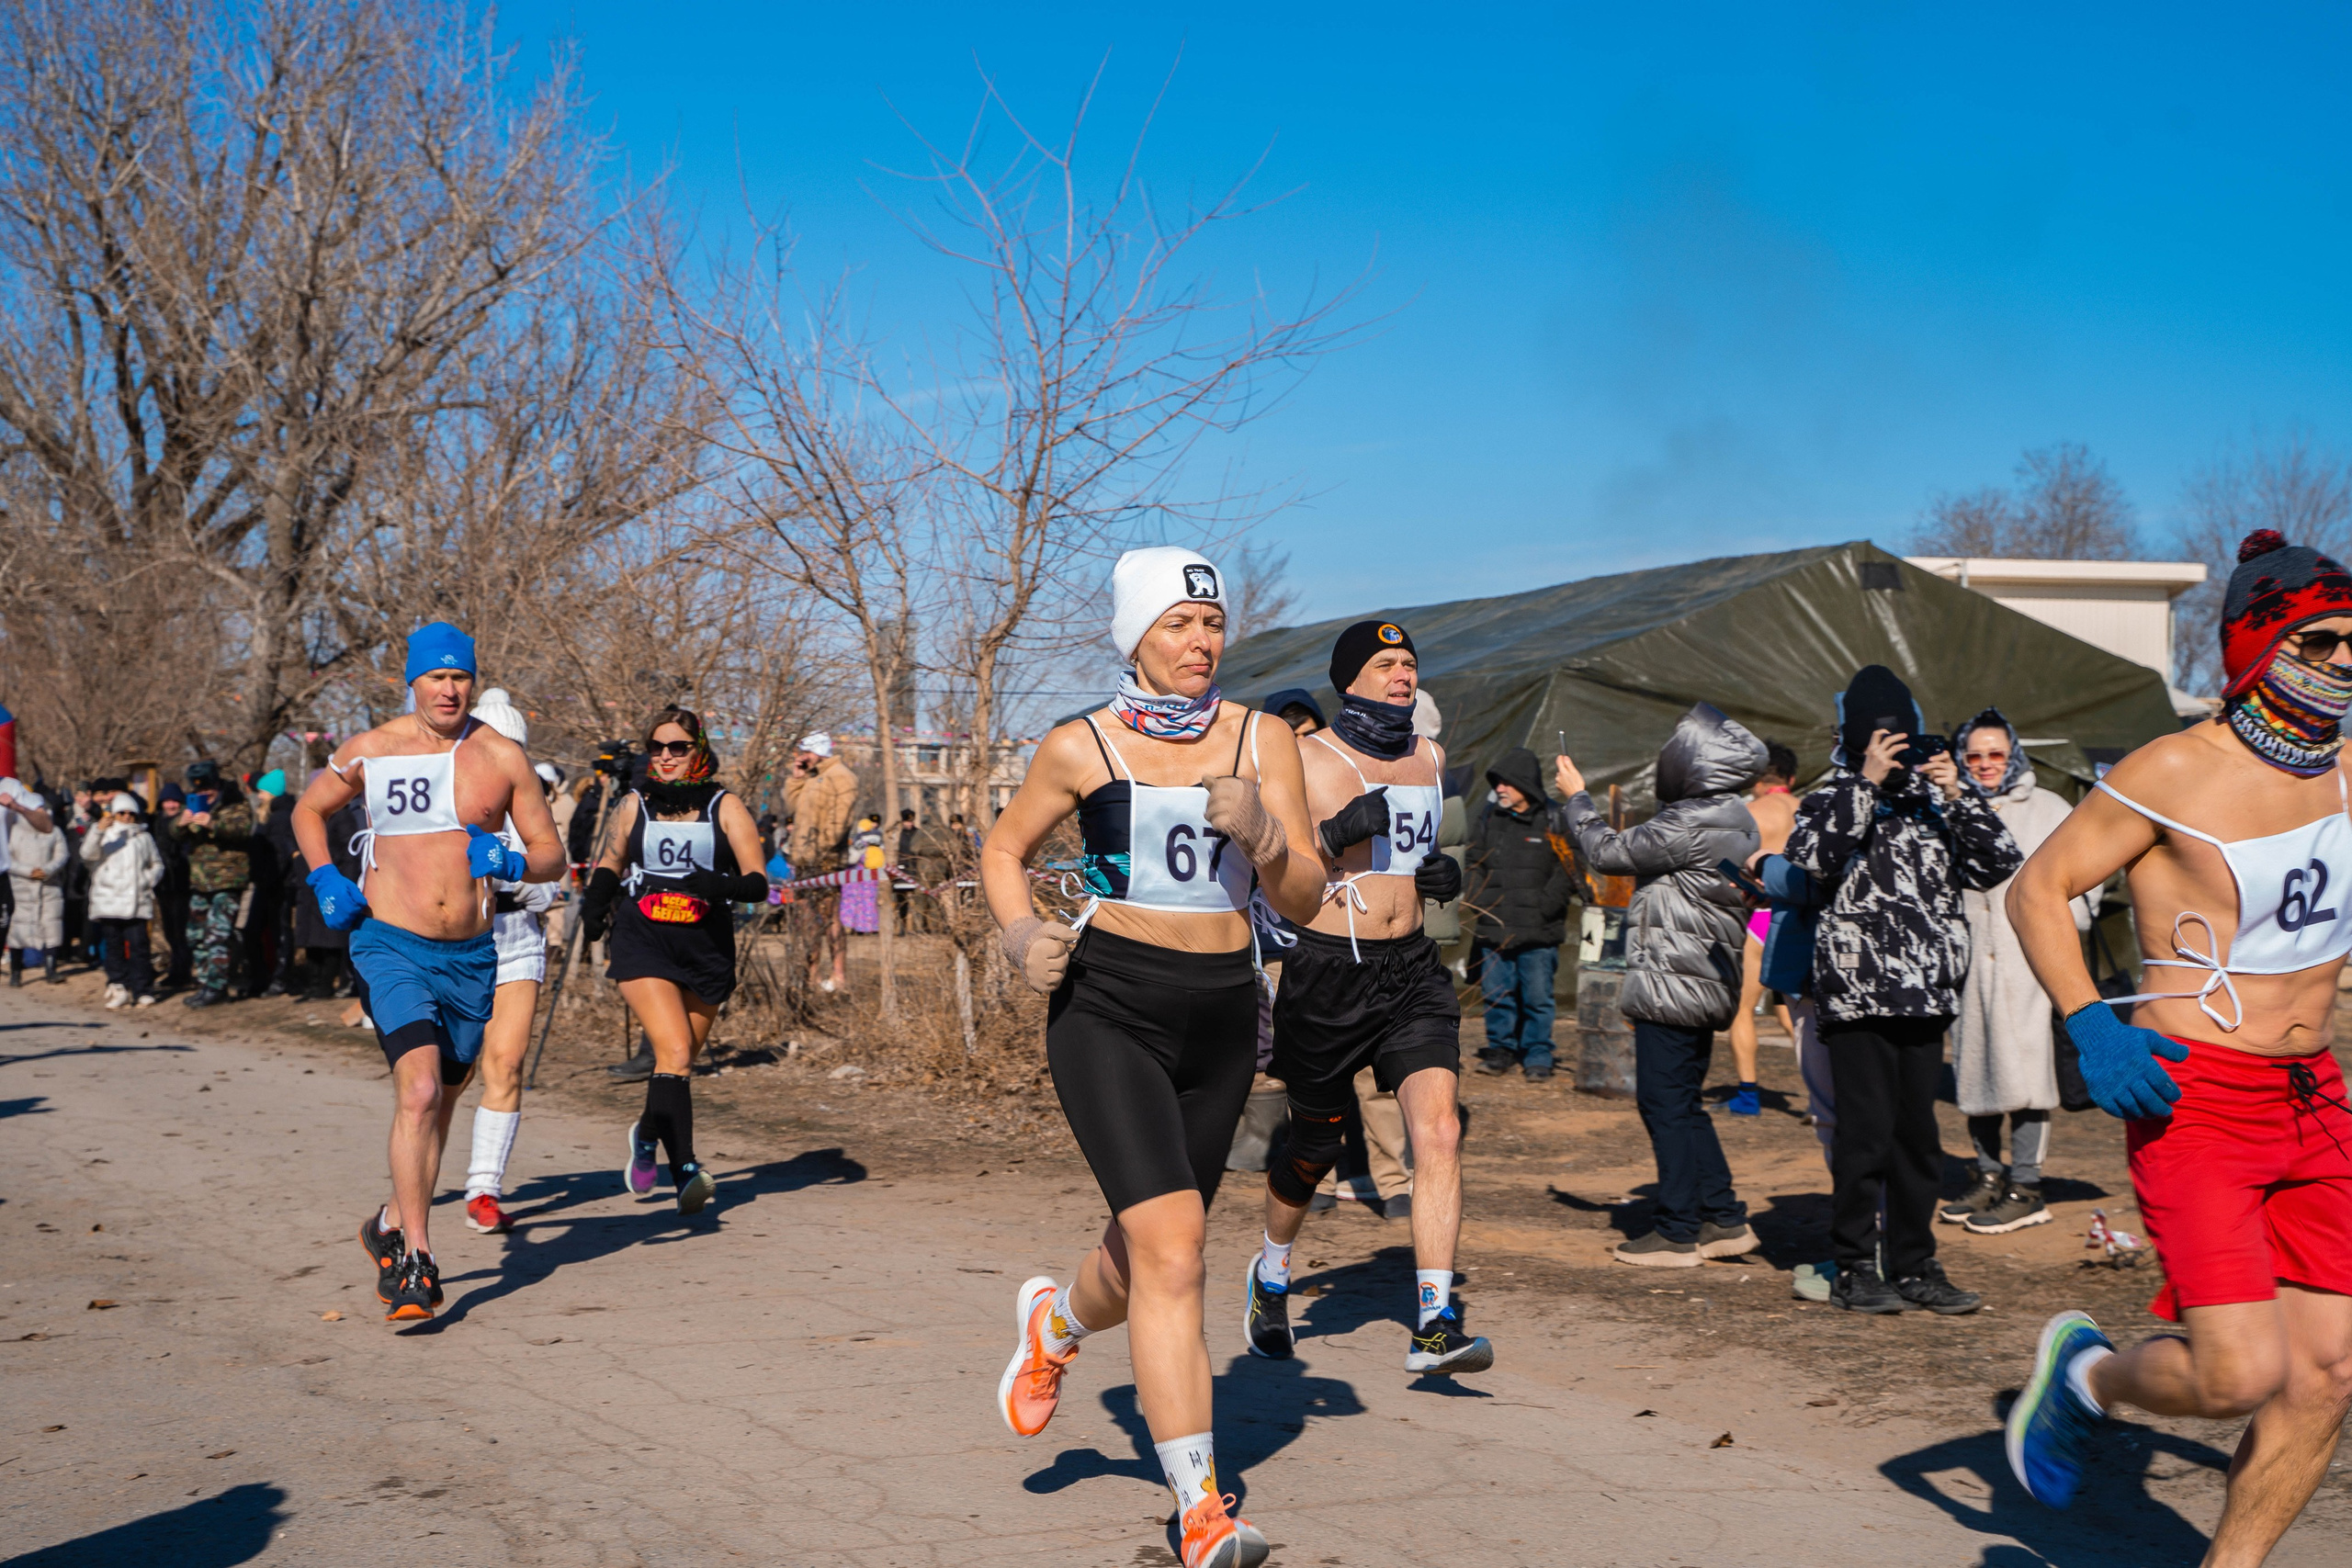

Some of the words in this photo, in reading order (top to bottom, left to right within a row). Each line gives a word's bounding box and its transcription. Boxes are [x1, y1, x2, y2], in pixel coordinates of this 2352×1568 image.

[387, 777, 431, 816] 58
[1396, 810, 1433, 853] 54
[659, 837, 694, 868] 64
[1166, 823, 1231, 882] 67
[651, 906, 695, 922] БЕГАТЬ
[2277, 858, 2338, 932] 62
